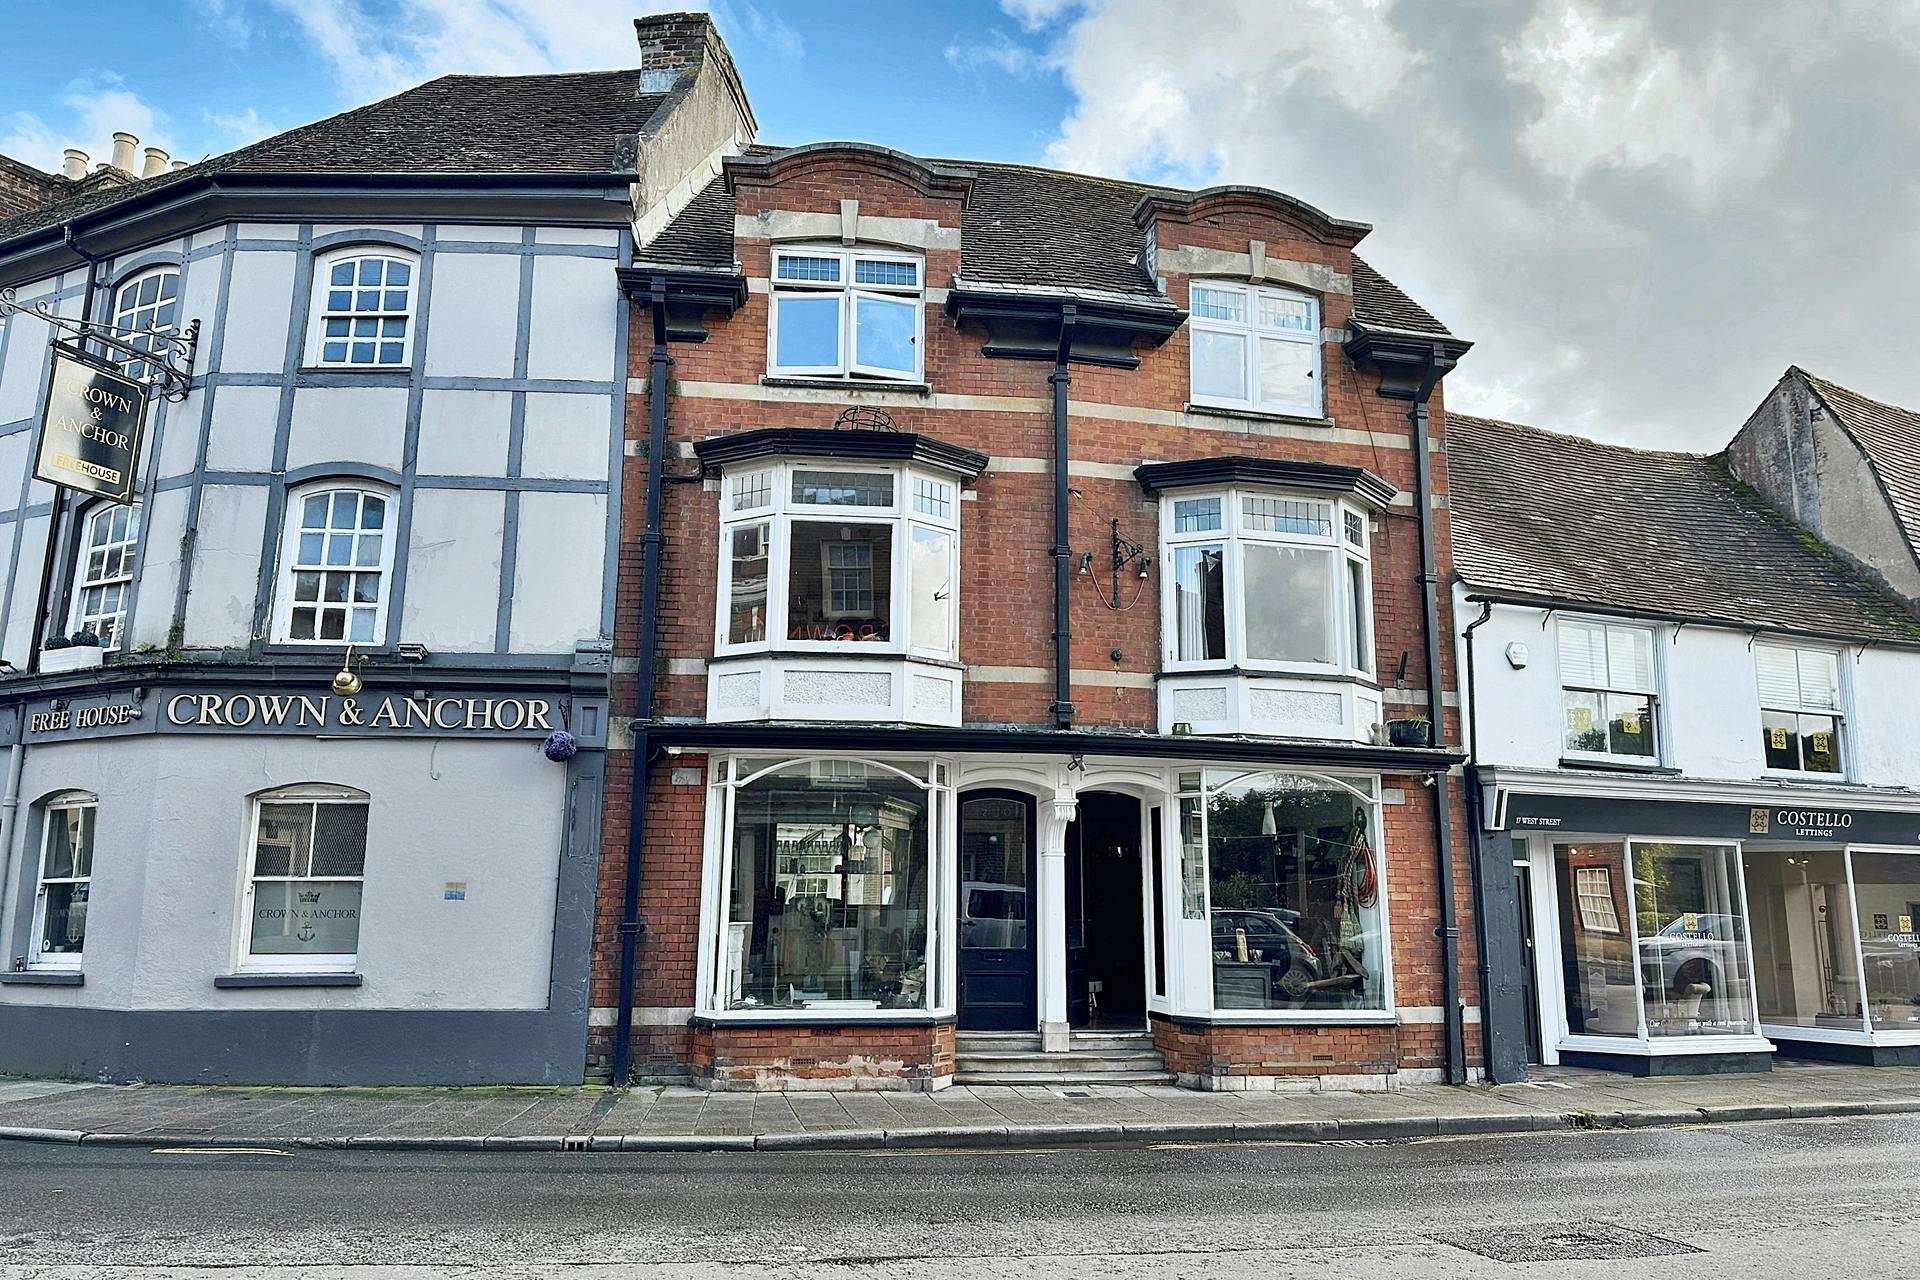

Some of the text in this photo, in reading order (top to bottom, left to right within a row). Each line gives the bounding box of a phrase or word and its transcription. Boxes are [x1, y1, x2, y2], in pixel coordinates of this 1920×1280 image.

[67, 383, 132, 414] CROWN
[90, 406, 103, 421] &
[55, 415, 129, 450] ANCHOR
[30, 704, 130, 732] FREE HOUSE
[167, 694, 553, 730] CROWN & ANCHOR
[1522, 817, 1538, 825] WEST
[1539, 818, 1561, 826] STREET
[1777, 811, 1852, 828] COSTELLO
[1795, 828, 1833, 837] LETTINGS
[258, 909, 299, 919] CROWN
[312, 909, 357, 919] ANCHOR
[1669, 932, 1714, 941] COSTELLO
[1887, 933, 1920, 942] COSTELL
